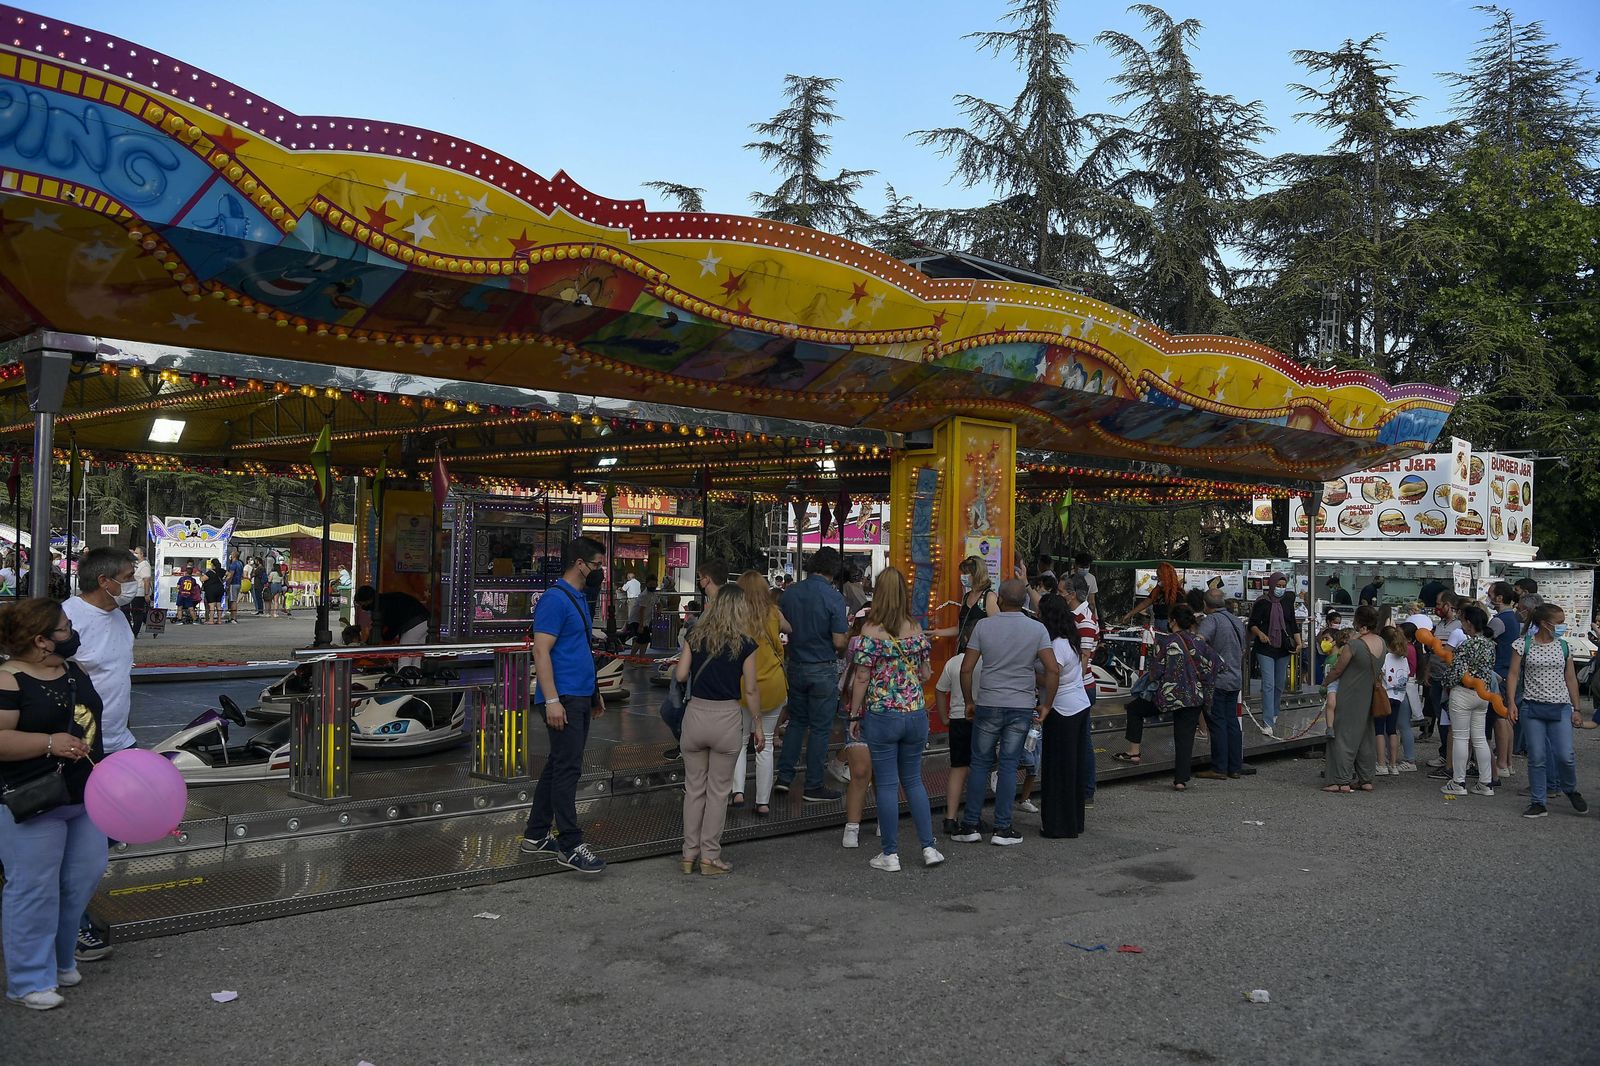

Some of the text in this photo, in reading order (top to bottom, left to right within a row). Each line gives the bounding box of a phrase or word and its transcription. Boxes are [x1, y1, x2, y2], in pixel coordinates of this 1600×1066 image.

[1405, 458, 1436, 472] J&R
[1491, 456, 1532, 477] BURGER J&R
[167, 541, 217, 549] TAQUILLA
[183, 581, 192, 591] 10
